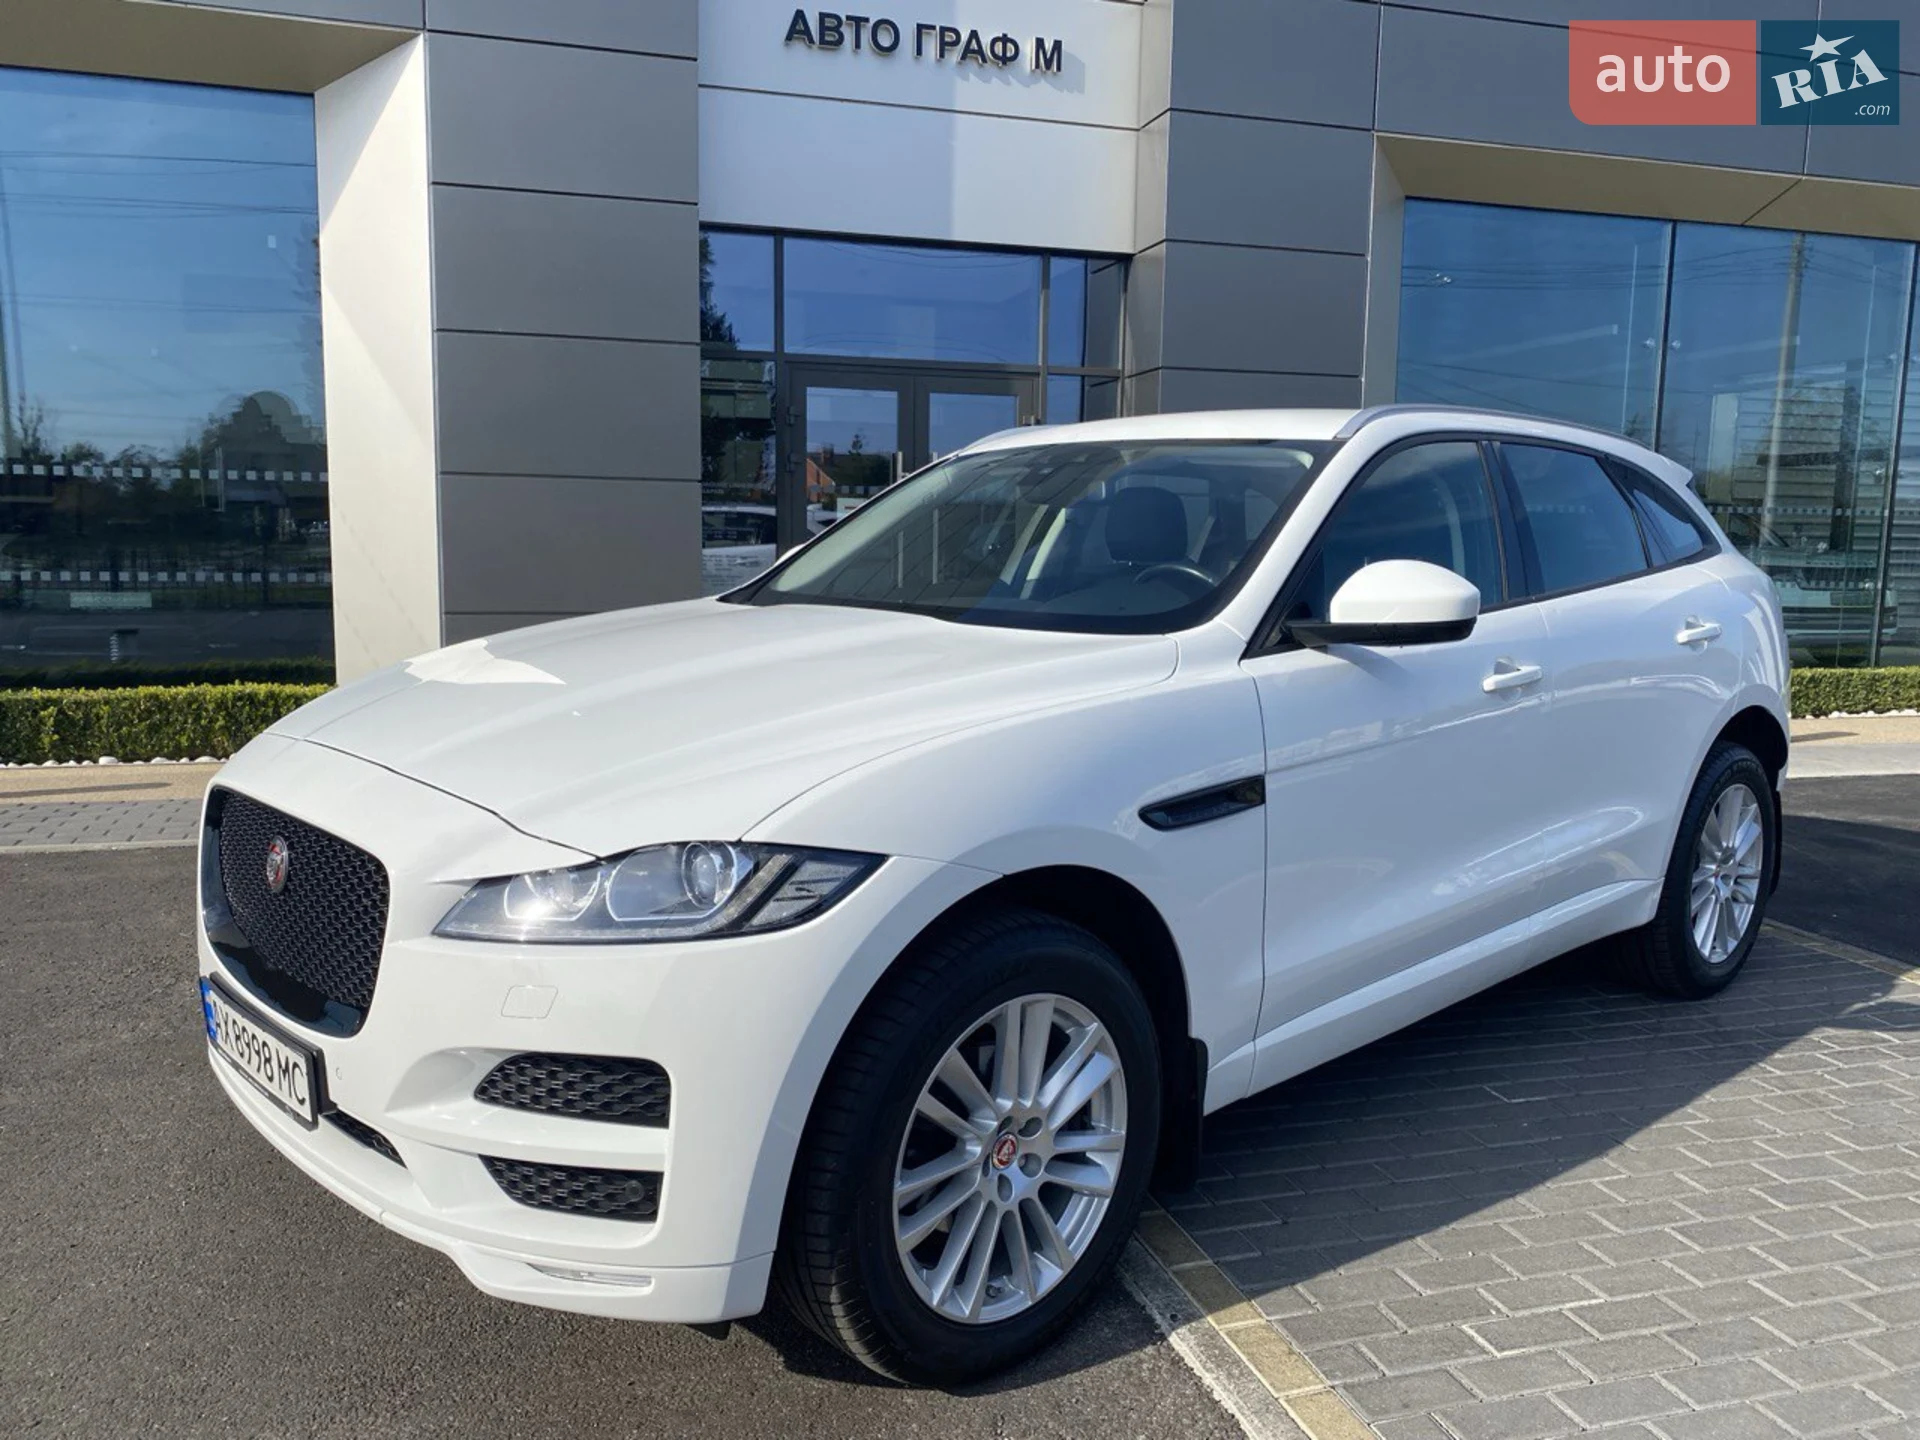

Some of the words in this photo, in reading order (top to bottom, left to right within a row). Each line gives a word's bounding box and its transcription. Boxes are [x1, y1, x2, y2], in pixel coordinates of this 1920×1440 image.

[784, 8, 901, 56] АВТО
[914, 22, 1020, 66] ГРАФ
[1032, 37, 1063, 73] М
